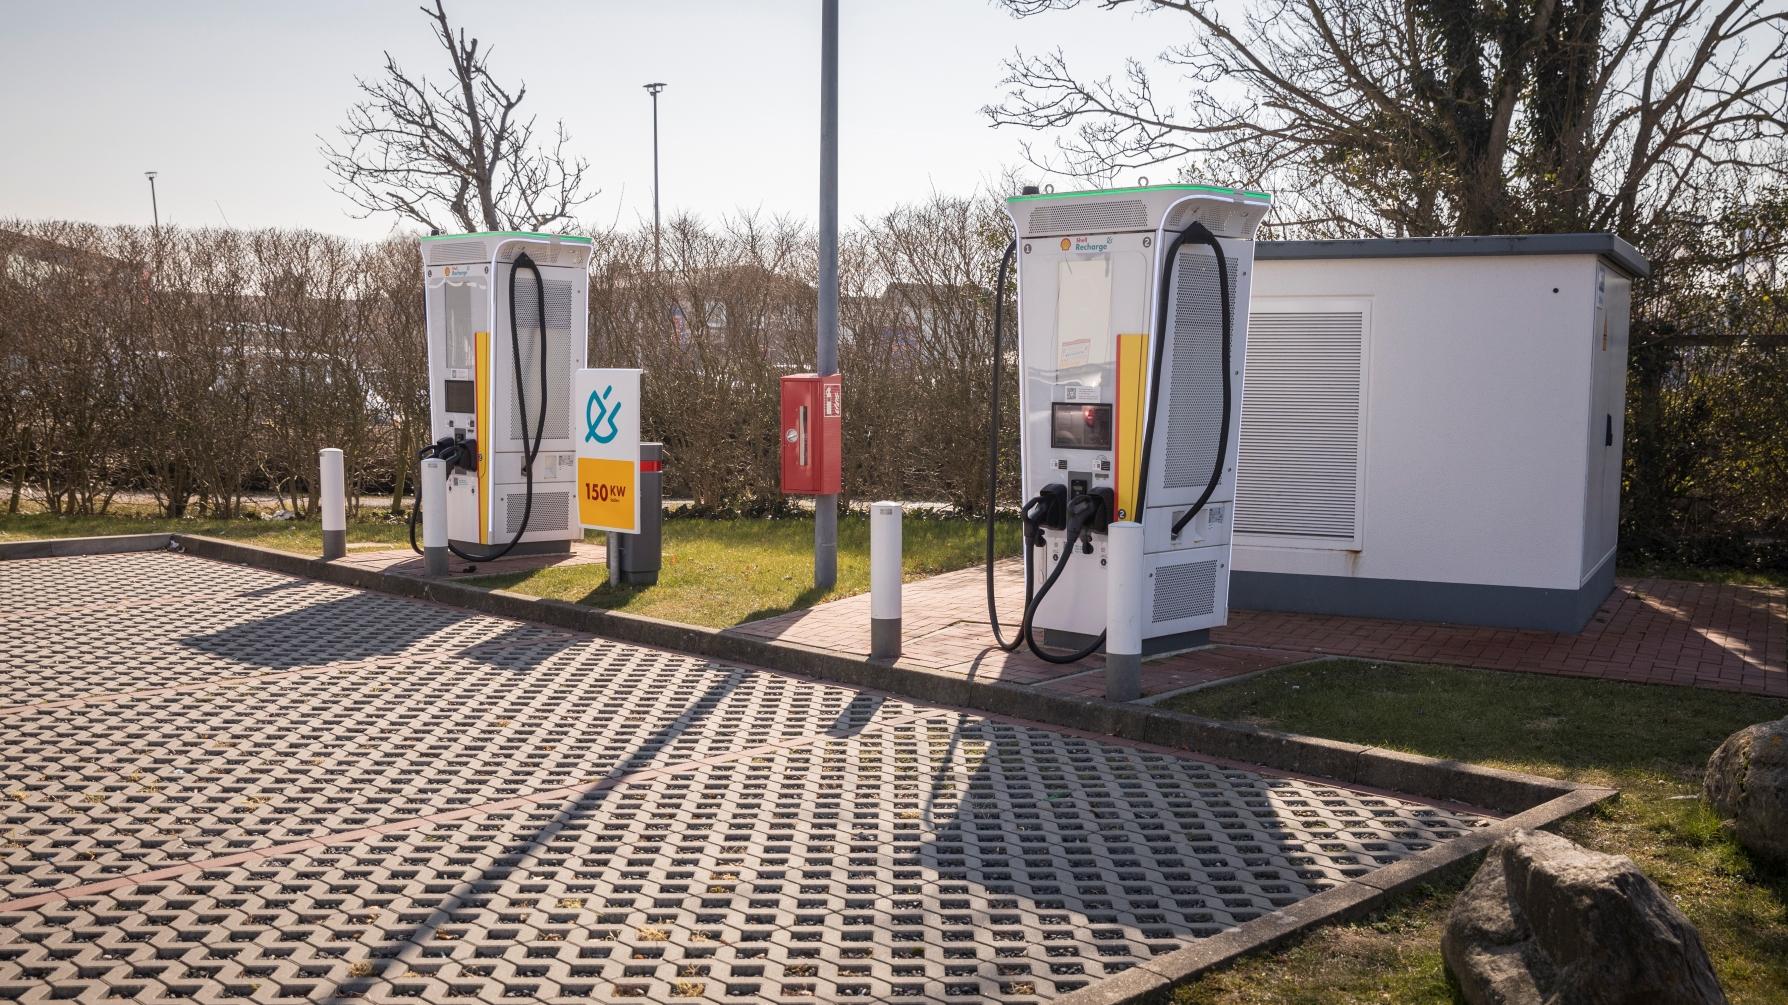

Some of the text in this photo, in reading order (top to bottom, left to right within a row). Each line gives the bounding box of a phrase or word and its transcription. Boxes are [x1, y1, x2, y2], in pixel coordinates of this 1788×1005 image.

[1075, 242, 1107, 252] Recharge
[585, 482, 626, 502] 150 KW
